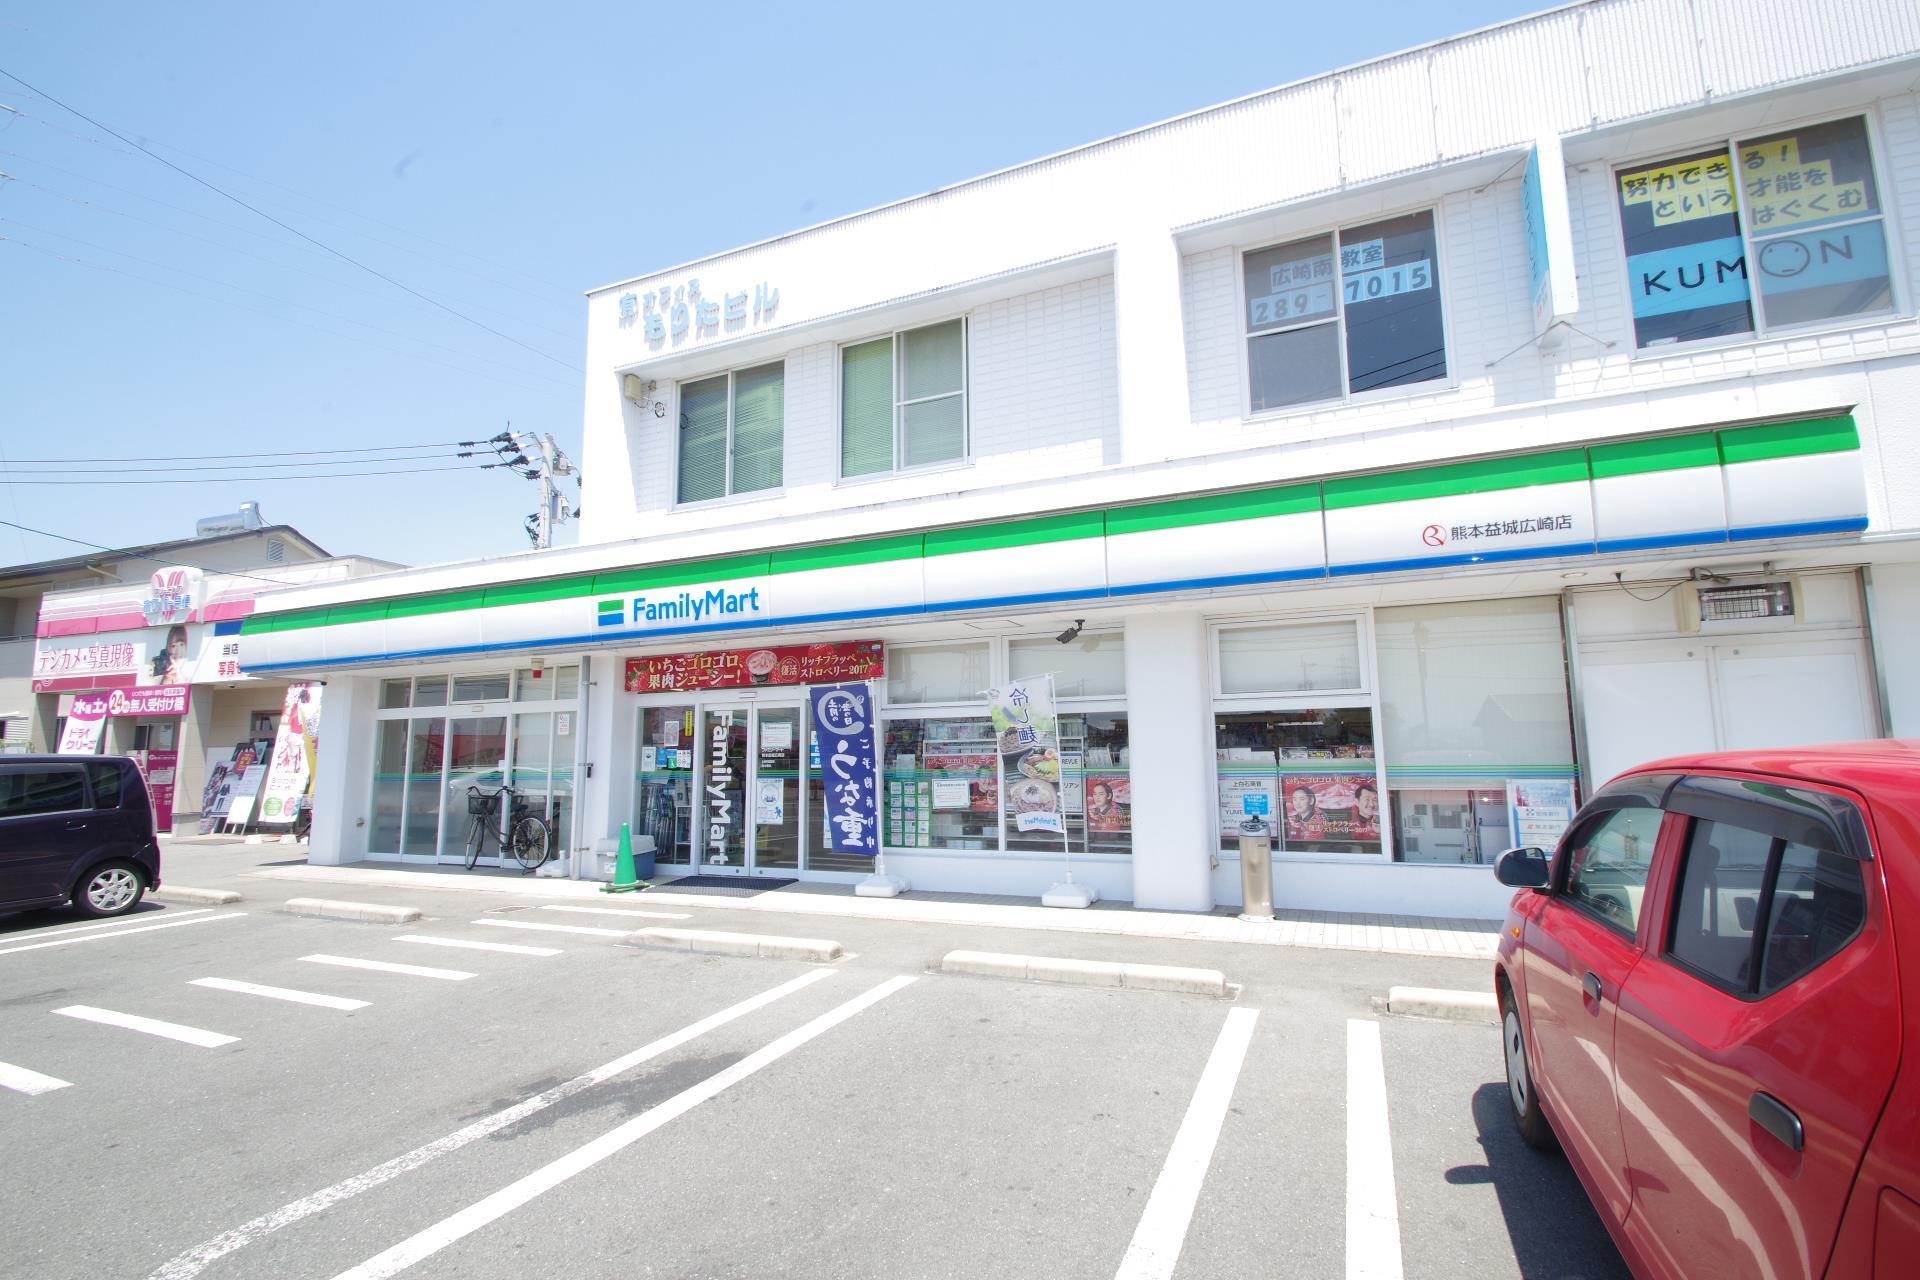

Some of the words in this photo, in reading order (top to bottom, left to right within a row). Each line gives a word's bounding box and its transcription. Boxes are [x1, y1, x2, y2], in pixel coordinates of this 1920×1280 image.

[1752, 188, 1863, 226] はぐくむ
[1272, 244, 1382, 287] 広崎南教室
[1643, 235, 1854, 296] KUMON
[1451, 514, 1572, 541] 熊本益城広崎店
[633, 586, 760, 622] FamilyMart
[39, 642, 135, 673] デジカメ・写真現像
[648, 652, 744, 674] いちごゴロゴロ、
[706, 710, 733, 866] FamilyMart
